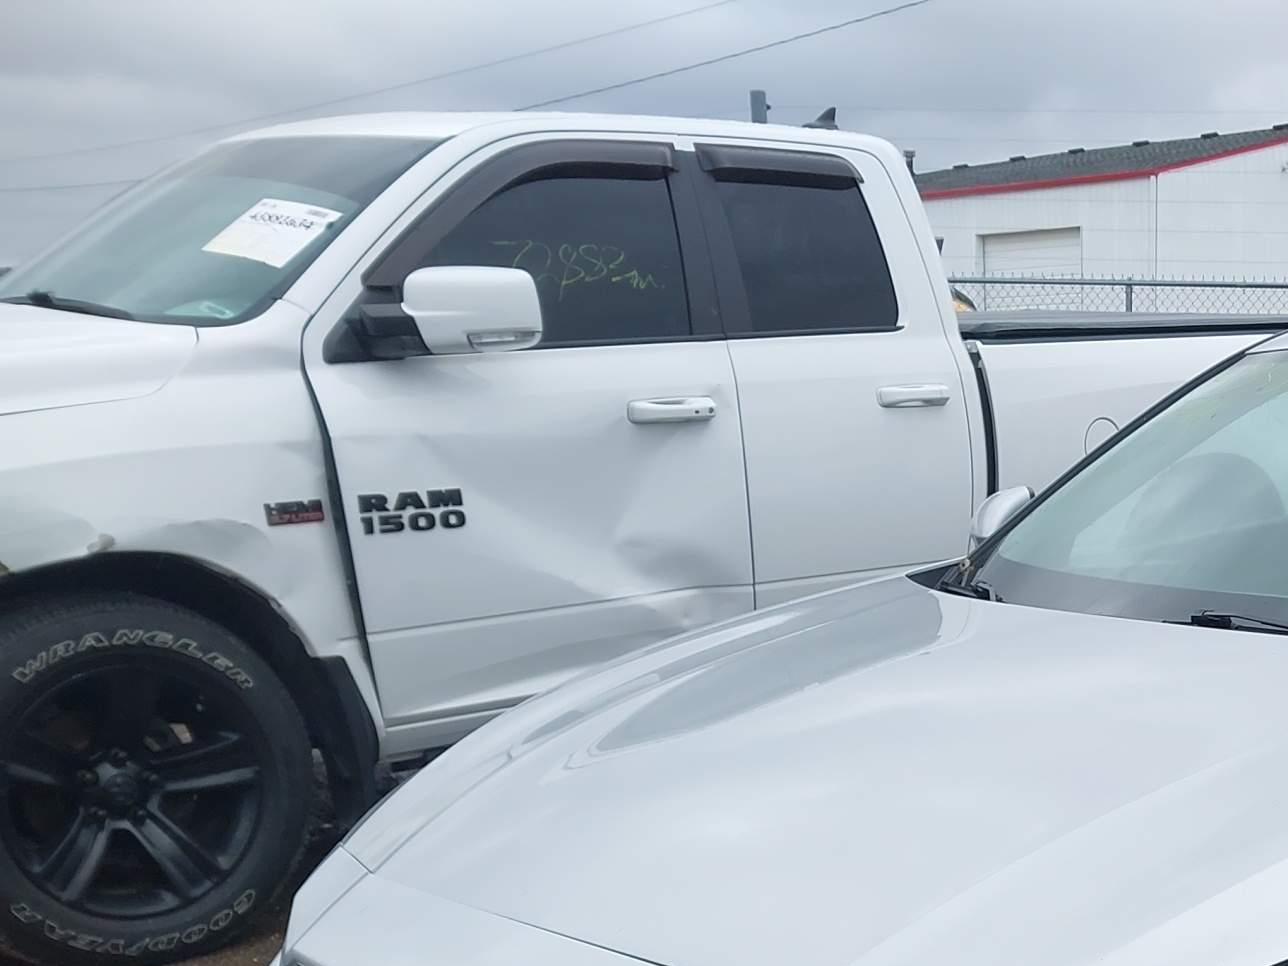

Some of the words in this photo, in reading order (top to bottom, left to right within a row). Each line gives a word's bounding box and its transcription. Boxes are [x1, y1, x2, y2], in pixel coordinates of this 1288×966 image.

[357, 488, 463, 514] RAM
[360, 509, 466, 535] 1500
[12, 628, 254, 690] WRANGLER
